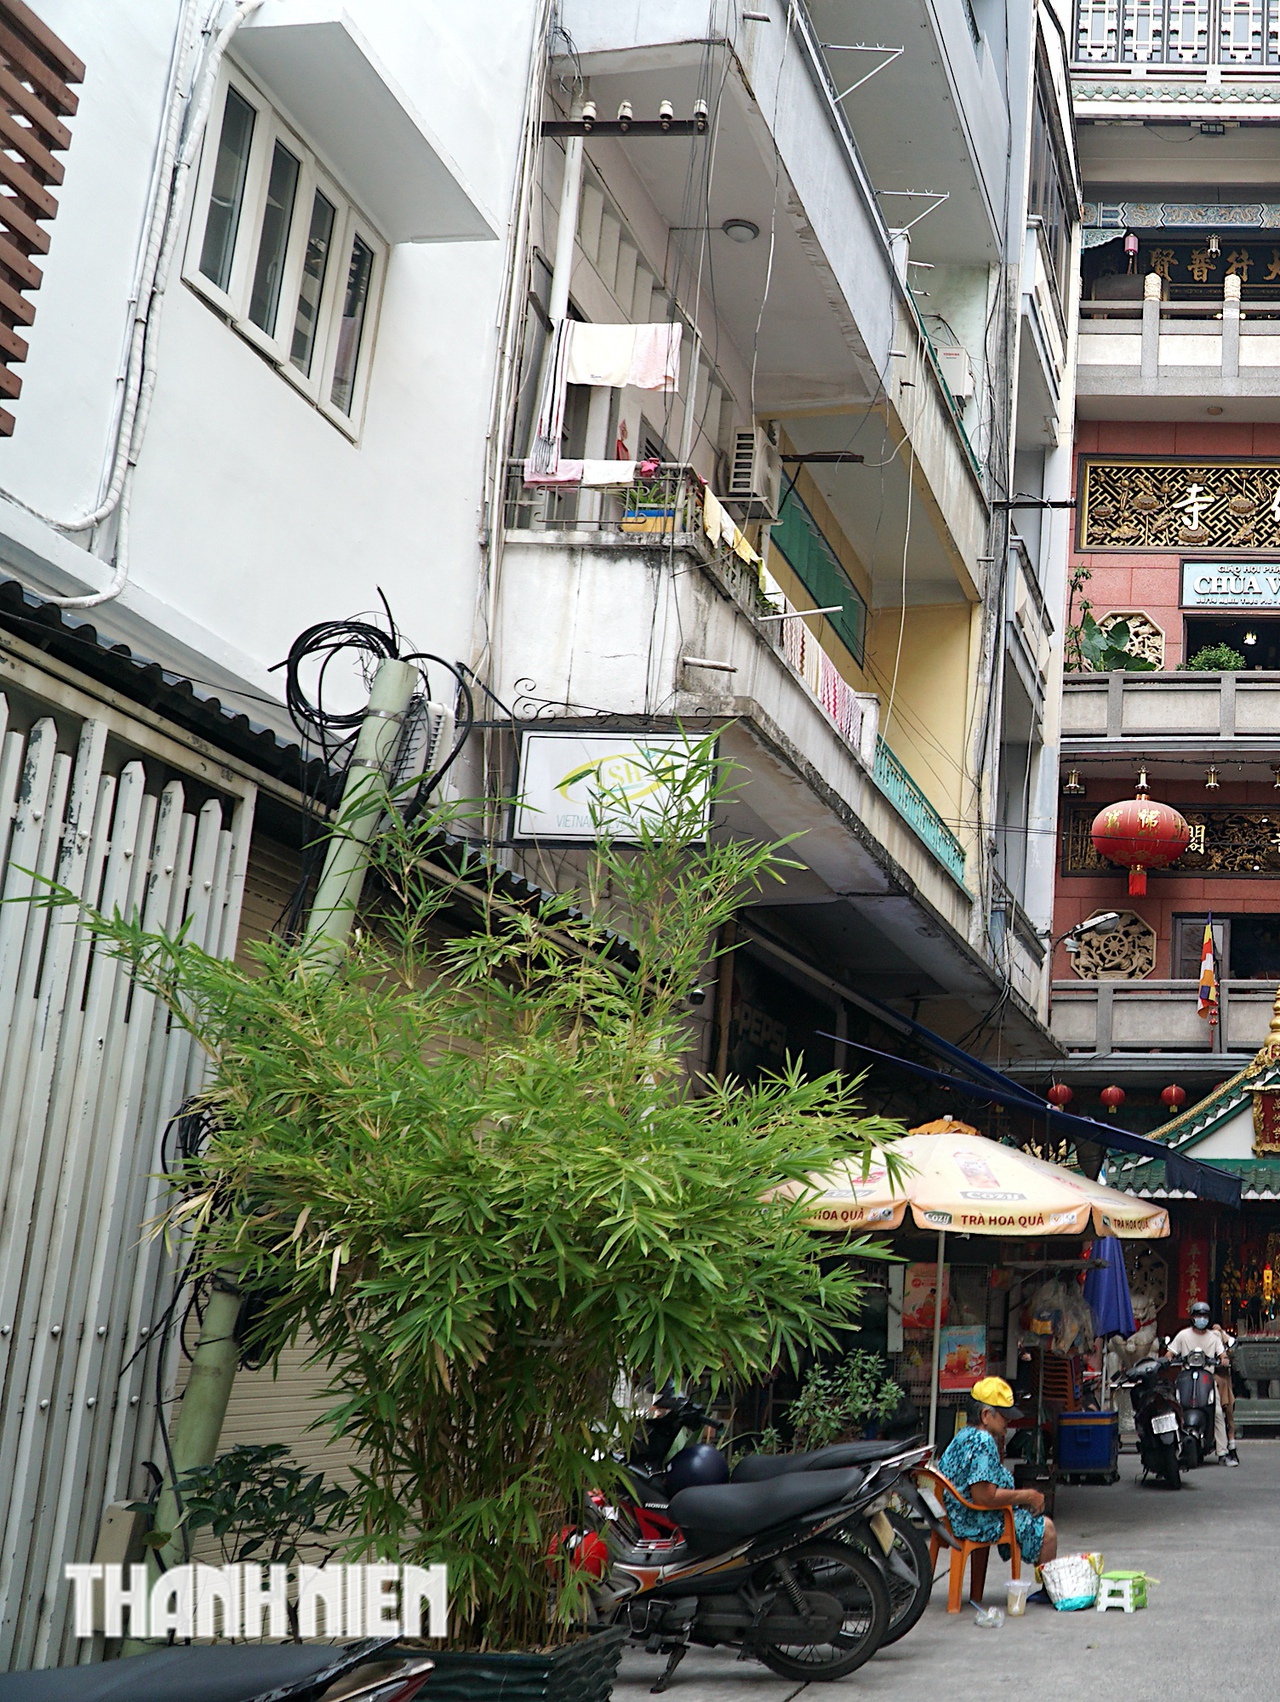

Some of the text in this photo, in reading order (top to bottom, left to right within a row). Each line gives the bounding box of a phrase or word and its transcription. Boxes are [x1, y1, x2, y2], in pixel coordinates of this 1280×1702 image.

[1193, 573, 1262, 594] CHÙA
[556, 814, 597, 829] VIETNA
[840, 1207, 864, 1223] QUẢ
[961, 1213, 1045, 1228] TRÀ HOA QUẢ
[1113, 1217, 1125, 1228] TRÀ
[1126, 1219, 1137, 1229] HOA
